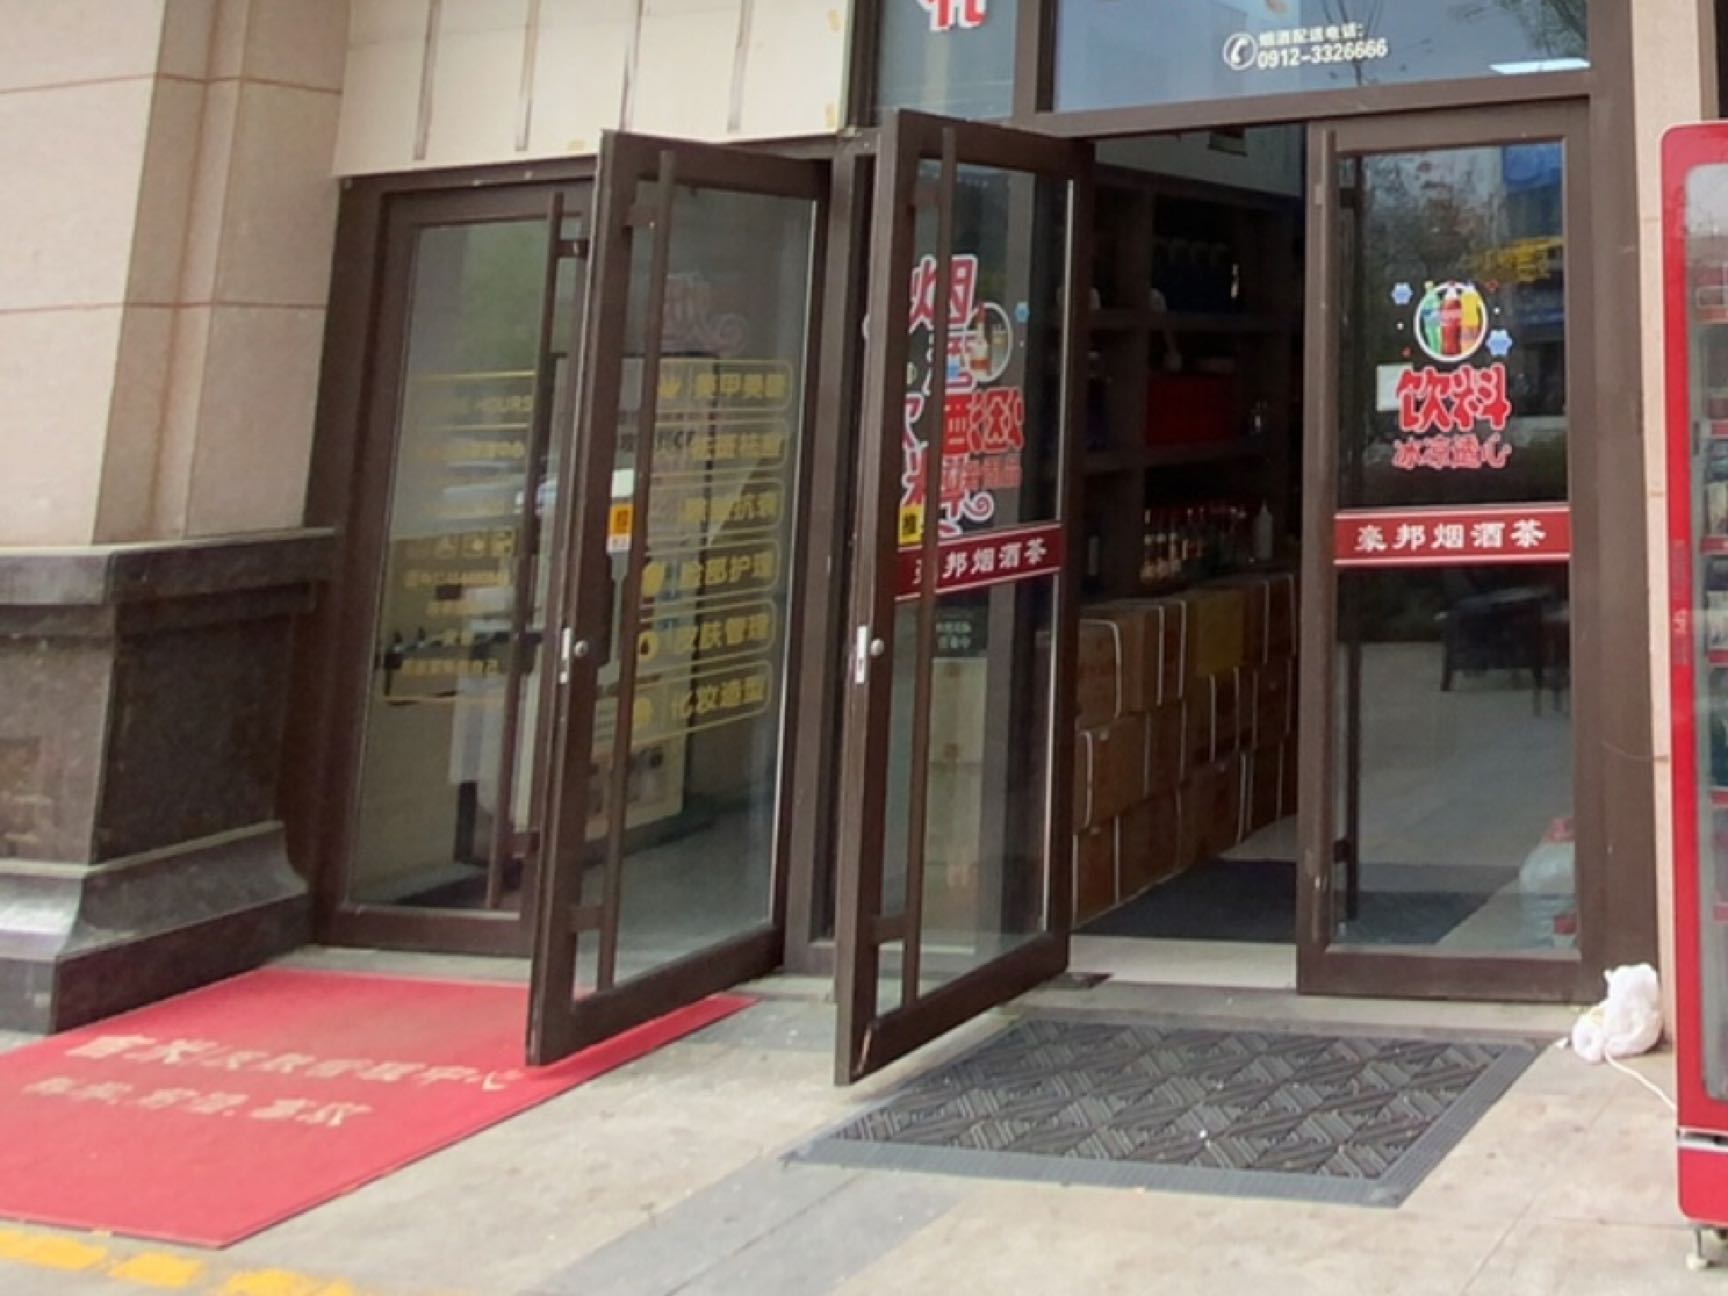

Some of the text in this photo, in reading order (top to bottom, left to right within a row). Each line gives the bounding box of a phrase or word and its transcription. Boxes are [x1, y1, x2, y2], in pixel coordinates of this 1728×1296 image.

[1256, 37, 1390, 70] 0912-3326666
[1395, 362, 1513, 433] 饮料
[912, 537, 1047, 585] 邦烟酒茶
